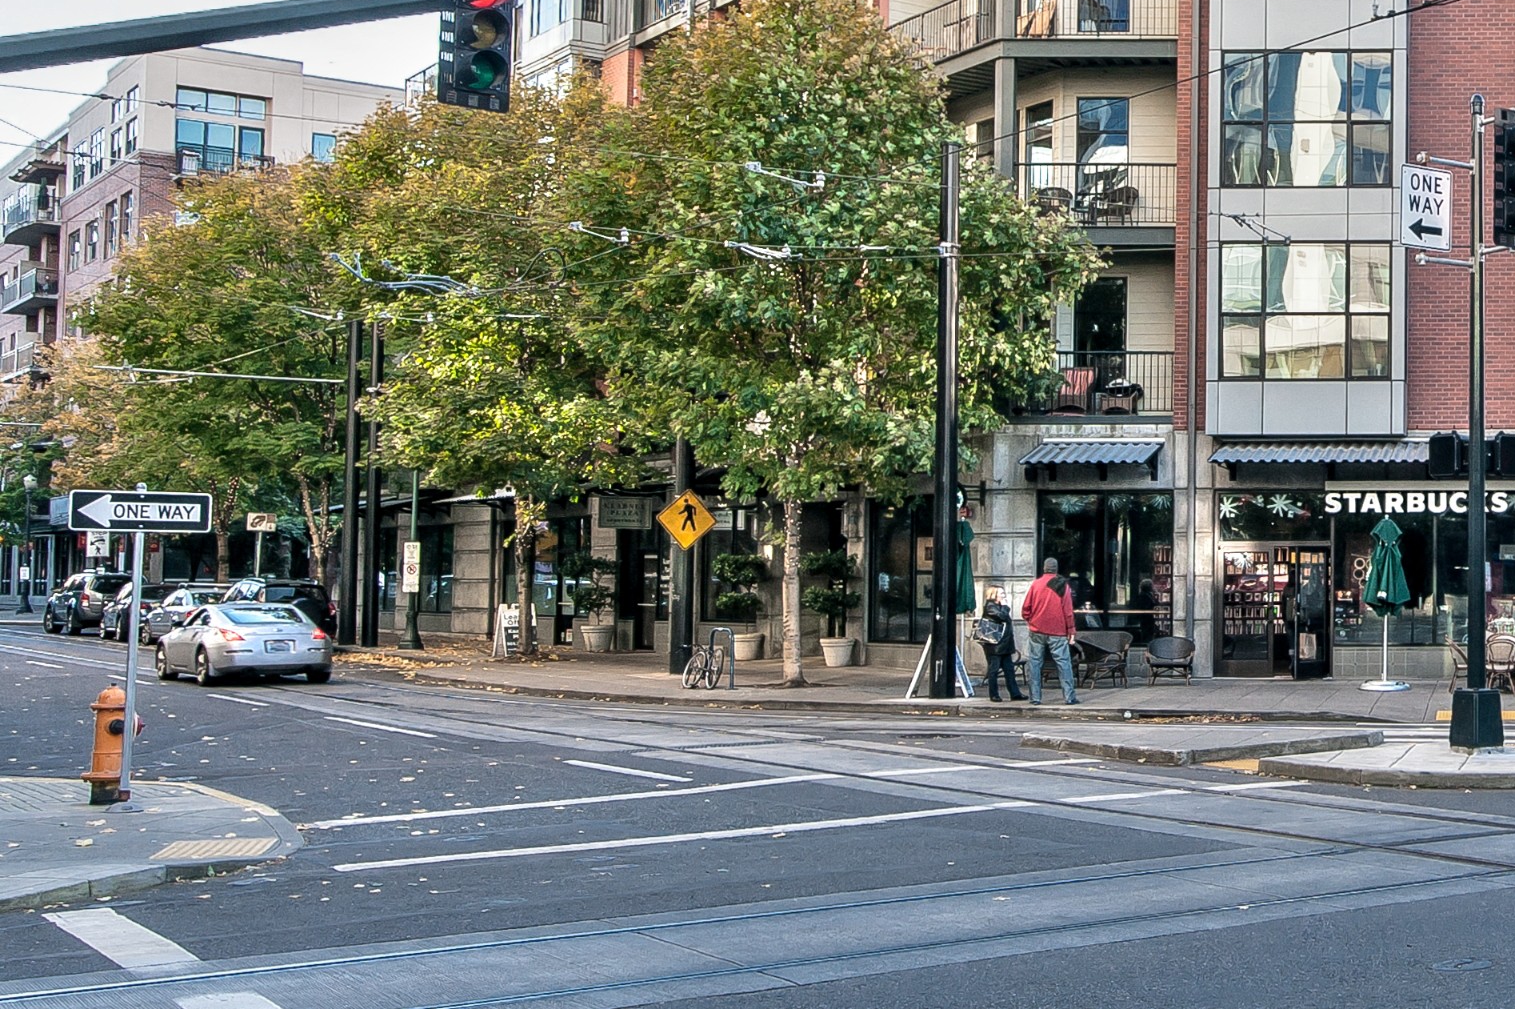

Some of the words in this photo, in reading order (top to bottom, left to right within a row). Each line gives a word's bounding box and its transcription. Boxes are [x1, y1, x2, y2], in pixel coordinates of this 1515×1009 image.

[1410, 173, 1443, 194] ONE
[1409, 194, 1444, 215] WAY
[113, 503, 150, 519] ONE
[158, 505, 195, 520] WAY
[1324, 491, 1508, 513] STARBUCS
